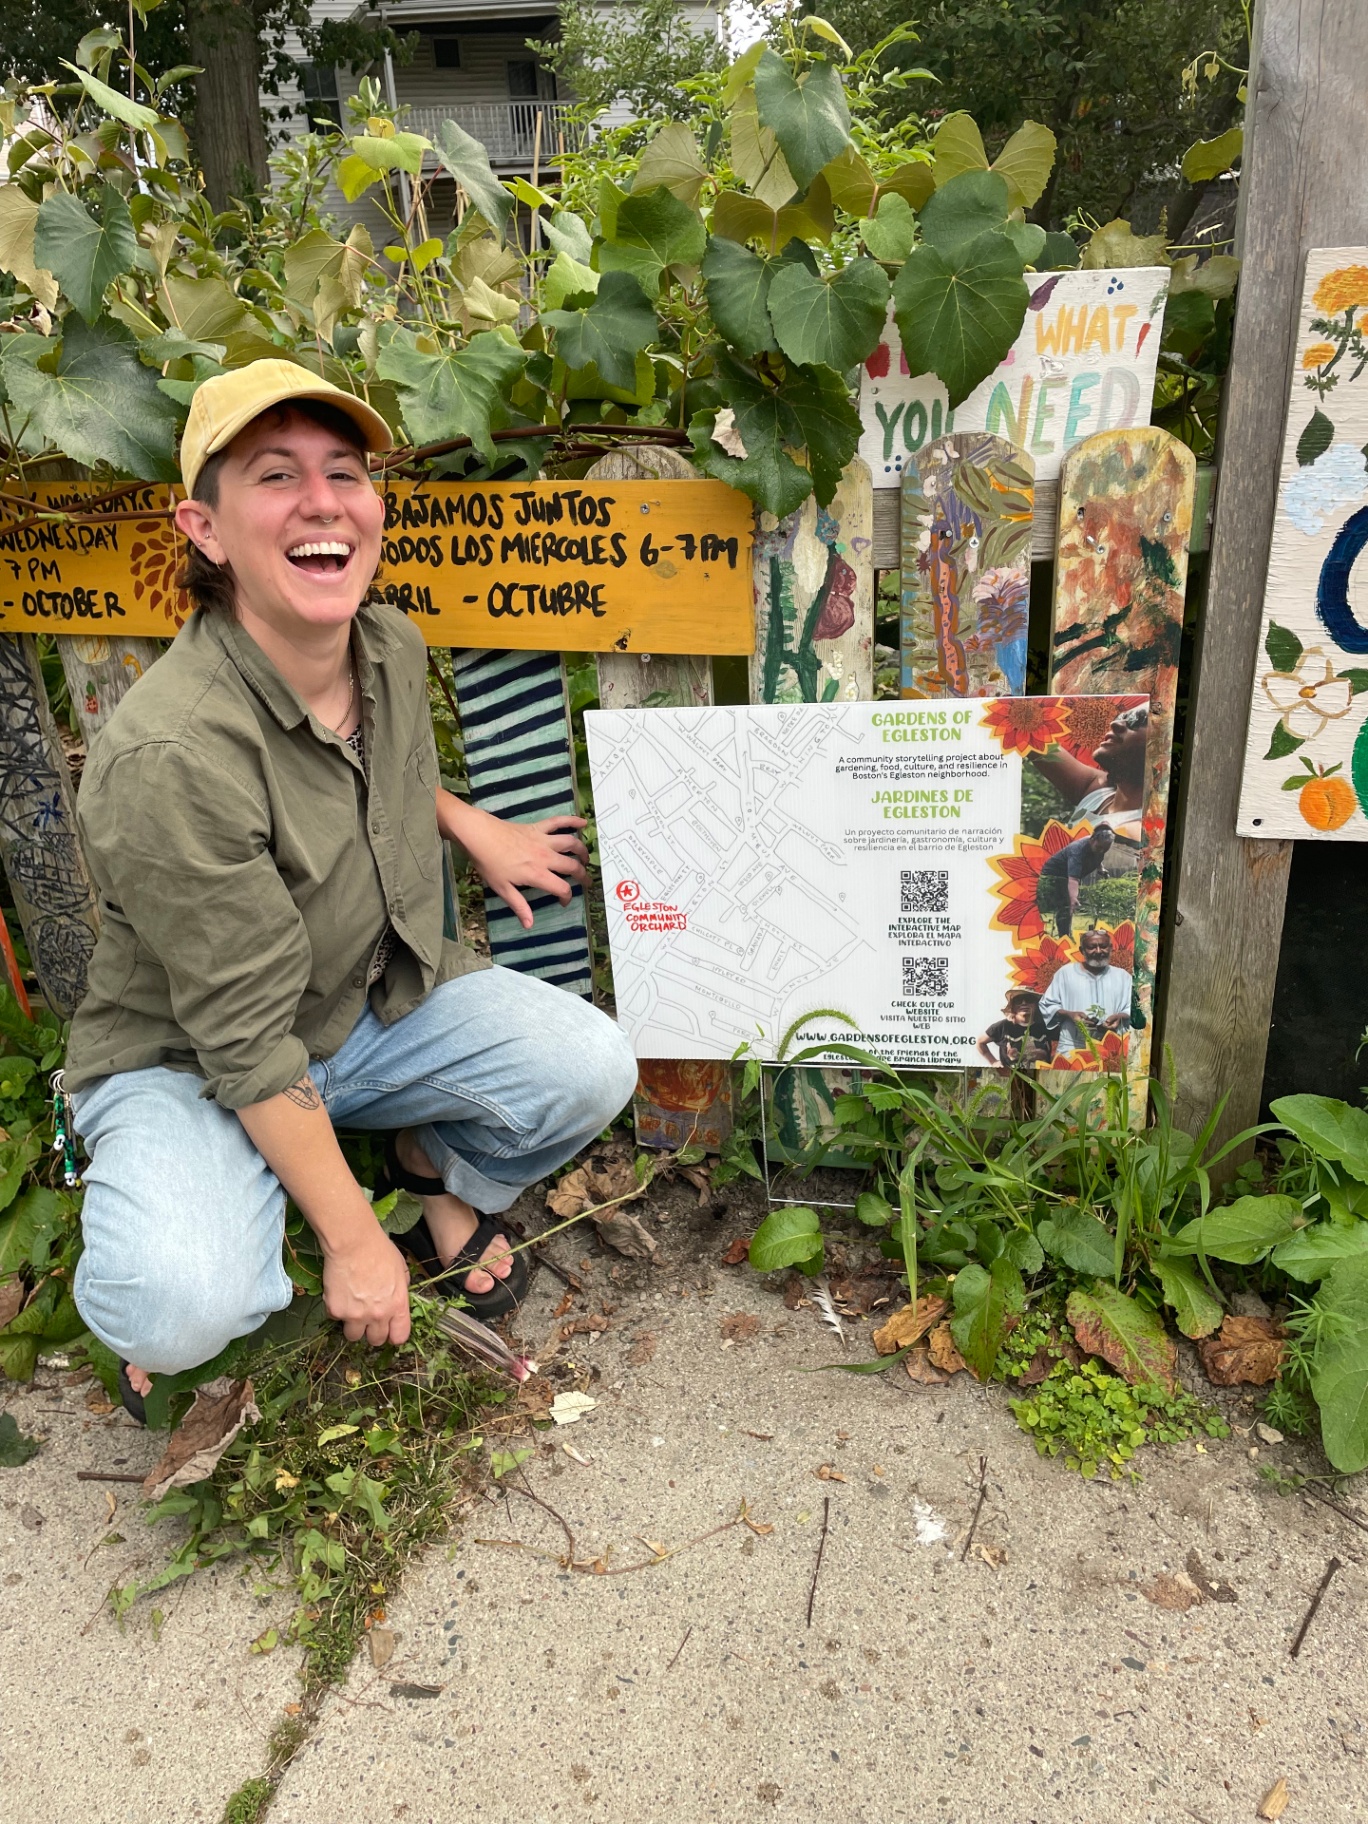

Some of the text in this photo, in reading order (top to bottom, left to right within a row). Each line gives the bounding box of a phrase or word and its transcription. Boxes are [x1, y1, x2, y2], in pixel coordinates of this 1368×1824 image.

[1035, 303, 1138, 356] WHAT
[875, 366, 1141, 461] YOU NEED
[384, 489, 616, 530] BAJAMOS JUNTOS
[451, 533, 496, 567] LOS
[501, 531, 627, 569] MIERCOLES
[22, 586, 126, 620] OCTOBER
[487, 582, 606, 617] OCTUBRE
[872, 710, 973, 727] GARDENS OF
[882, 728, 962, 743] EGLESTON
[846, 756, 893, 764] community
[895, 754, 944, 764] storytelling
[946, 753, 976, 762] project
[904, 762, 937, 771] culture,
[938, 762, 954, 770] and
[956, 761, 998, 769] resilience
[852, 770, 990, 780] Boston's Egleston neighborhood.
[872, 789, 973, 804] JARDINES DE
[883, 806, 961, 818] EGLESTON
[858, 829, 895, 837] proyecto
[962, 827, 1002, 835] narración
[854, 844, 895, 852] resiliencia
[958, 844, 993, 853] Egleston
[623, 902, 678, 912] EGLESTON
[626, 913, 688, 924] COMMUNITY
[630, 921, 687, 932] ORCHARD
